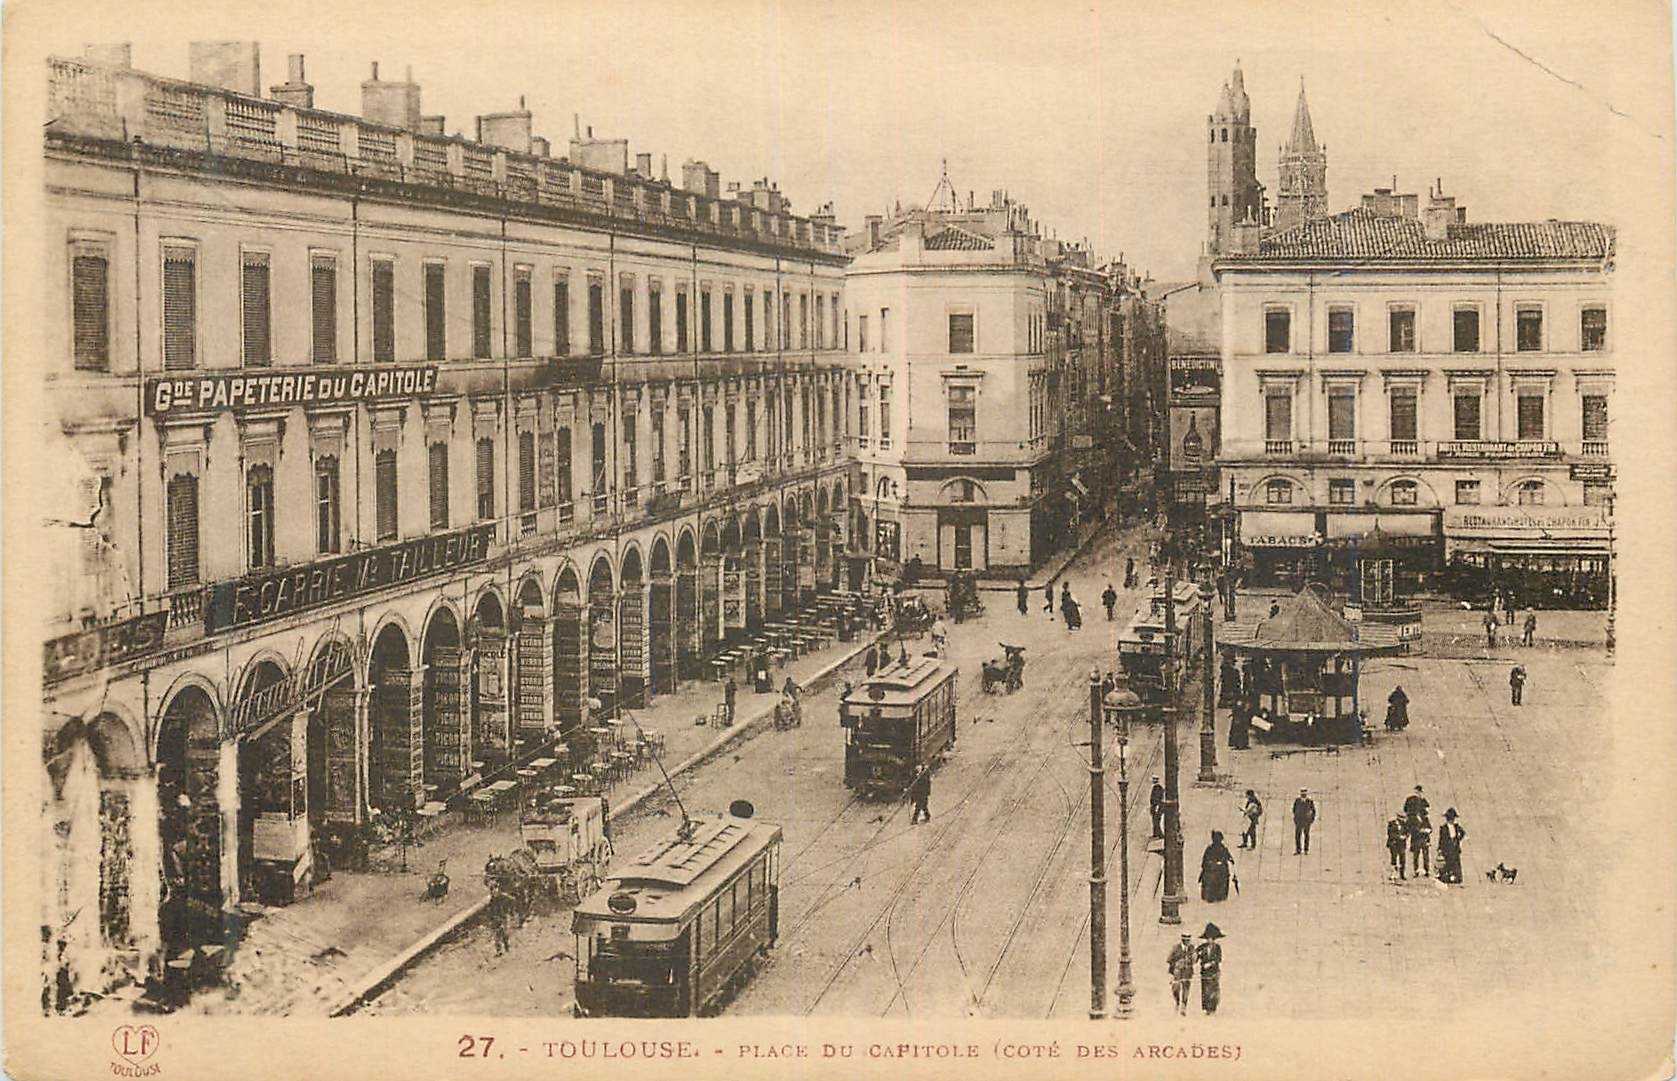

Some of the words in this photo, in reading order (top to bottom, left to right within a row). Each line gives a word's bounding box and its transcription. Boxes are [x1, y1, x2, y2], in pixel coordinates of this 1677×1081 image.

[198, 375, 316, 408] PAPETERIE
[318, 377, 346, 400] DU
[350, 369, 434, 398] CAPITOLE
[391, 533, 481, 582] TAILLEUR
[1250, 536, 1307, 545] TABACS
